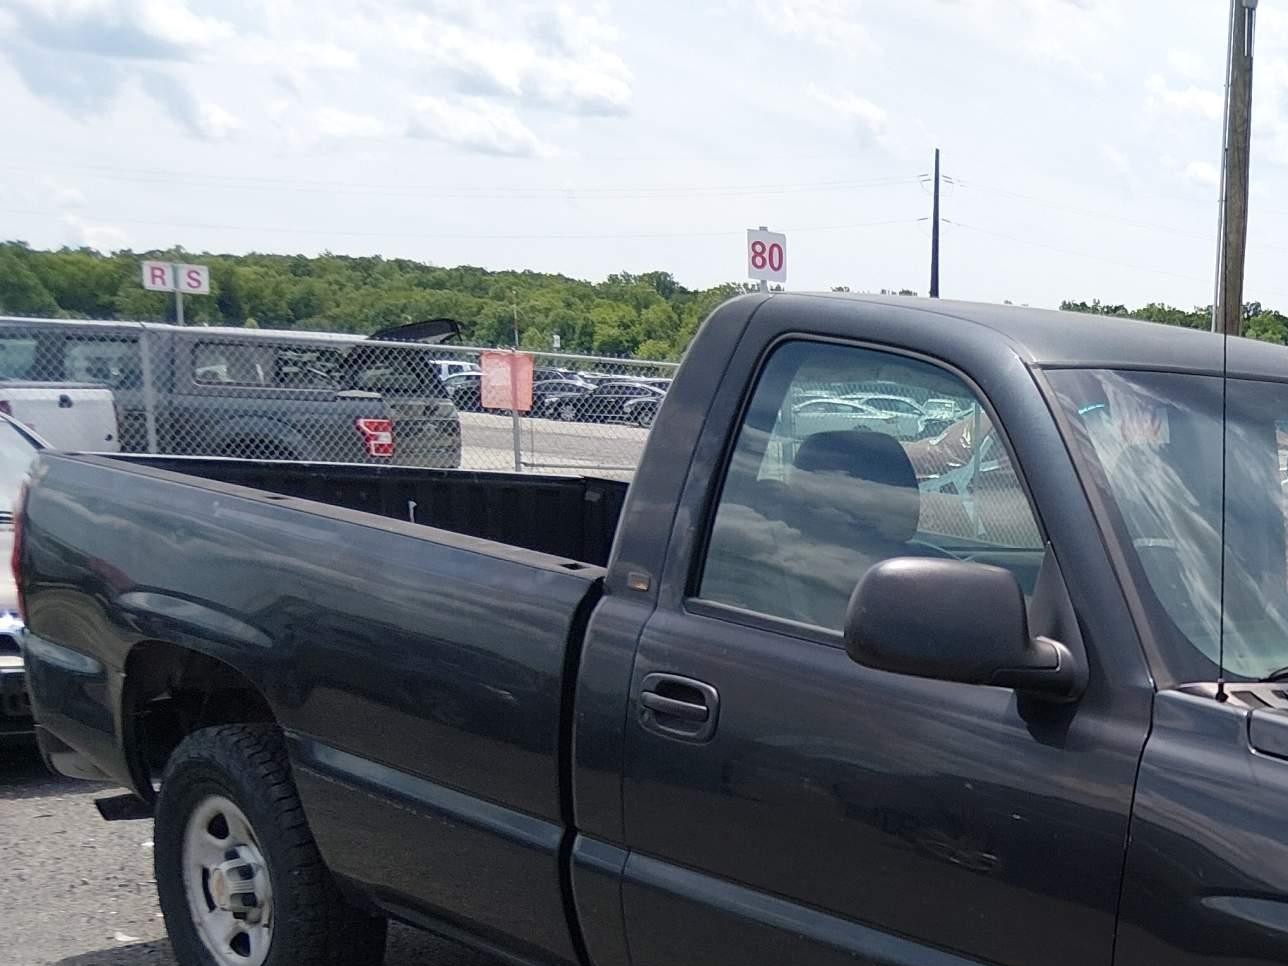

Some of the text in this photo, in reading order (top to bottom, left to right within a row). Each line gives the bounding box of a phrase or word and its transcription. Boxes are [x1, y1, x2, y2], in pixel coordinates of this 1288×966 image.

[751, 240, 784, 272] 80
[150, 266, 166, 286] R
[187, 270, 202, 289] S
